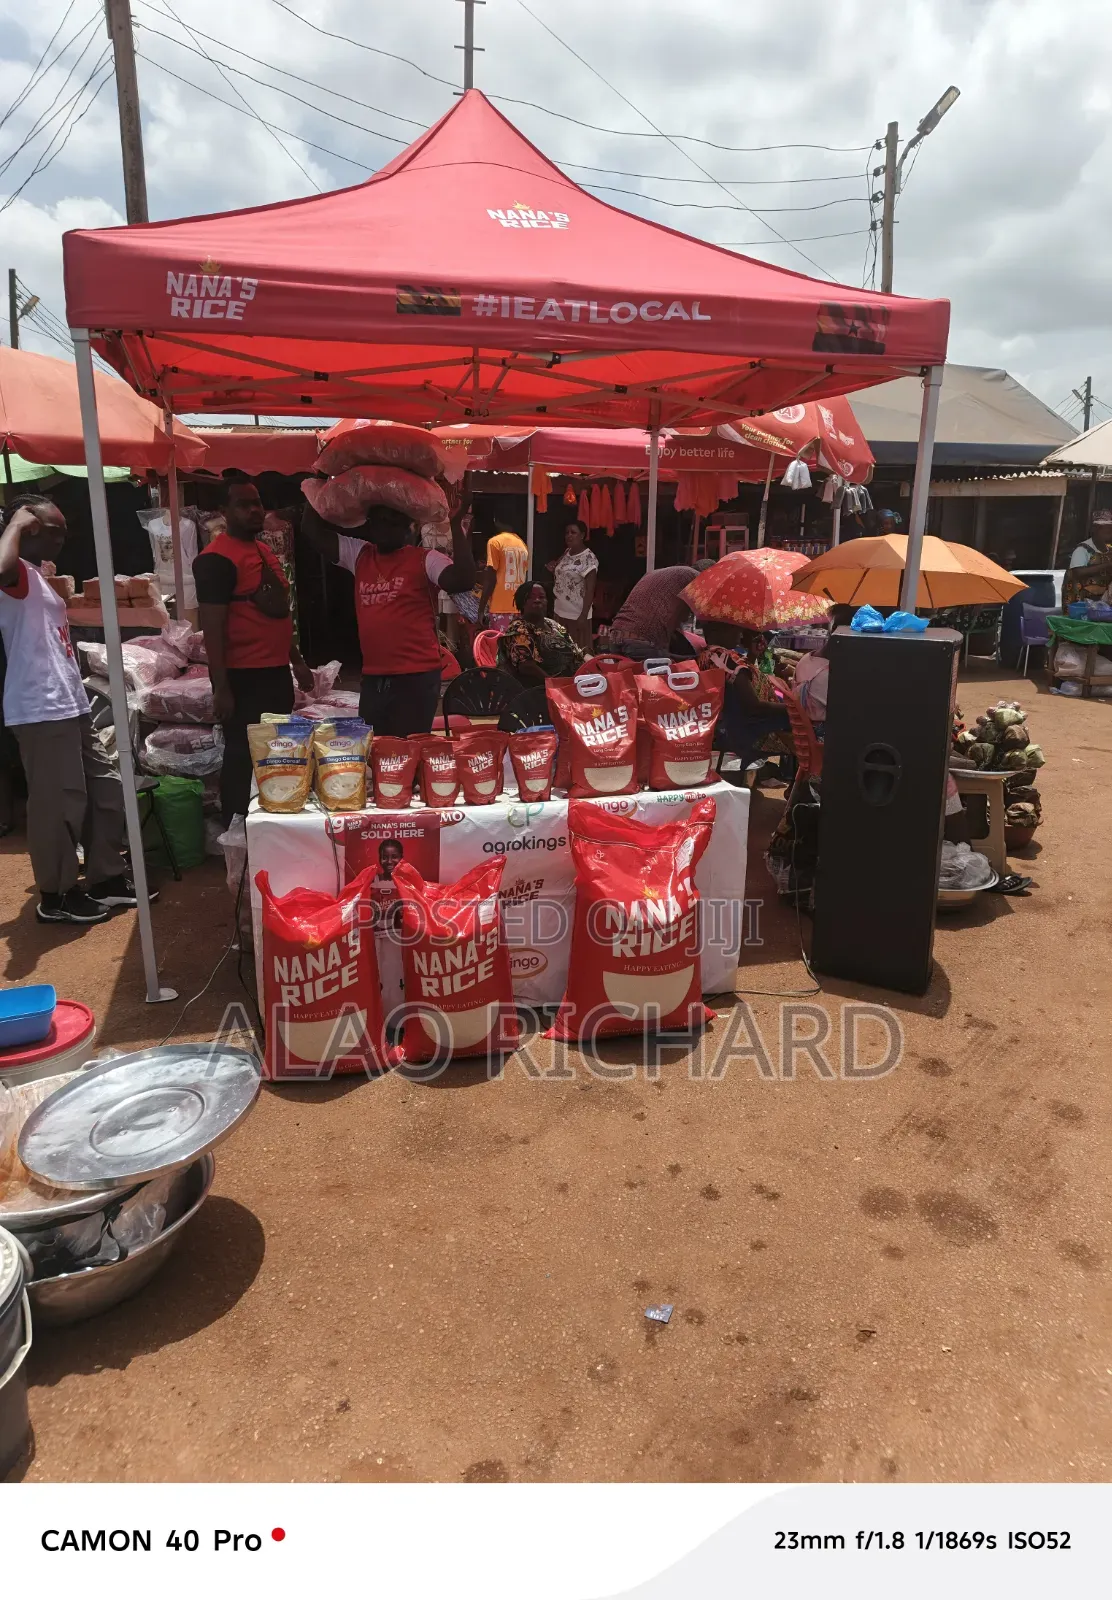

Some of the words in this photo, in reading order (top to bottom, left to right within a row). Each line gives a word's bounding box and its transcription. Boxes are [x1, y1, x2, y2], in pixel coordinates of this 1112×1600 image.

[486, 209, 570, 222] NANA'S
[499, 219, 569, 229] RICE
[166, 271, 259, 301] NANA'S
[170, 297, 247, 320] RICE
[471, 293, 711, 324] #IEATLOCAL
[442, 438, 462, 446] artner
[463, 438, 473, 446] for
[741, 423, 756, 434] Your
[757, 428, 781, 444] partner
[783, 437, 794, 447] for
[745, 432, 762, 443] clean
[763, 437, 787, 450] clothes
[645, 444, 677, 459] Ejoy
[680, 446, 715, 458] better
[718, 447, 735, 459] life
[573, 704, 630, 736] NANA'S
[657, 702, 712, 729] NANA'S
[581, 723, 629, 747] RICE
[664, 719, 711, 741] RICE
[271, 739, 294, 749] dingo
[330, 740, 352, 748] dingo
[379, 754, 409, 766] NANA'S
[467, 750, 494, 768] NANA'S
[520, 749, 549, 764] NANA'S
[523, 758, 548, 771] RICE
[380, 763, 405, 773] RICE
[431, 761, 457, 773] RICE
[471, 758, 494, 774] RICE
[597, 799, 629, 813] ingo
[440, 810, 463, 823] MO
[361, 830, 392, 840] SOLD
[394, 828, 425, 839] HERE
[371, 822, 398, 830] NANA'S
[483, 835, 566, 855] agrokings
[498, 878, 545, 899] NANA'S
[502, 890, 540, 910] RICE
[612, 911, 695, 958] RICE
[273, 926, 362, 983] NANA'S
[412, 927, 499, 976] NANA'S
[510, 956, 540, 970] ingo
[624, 964, 651, 972] HAPPY
[280, 960, 360, 1008] RICE
[420, 956, 495, 997] RICE
